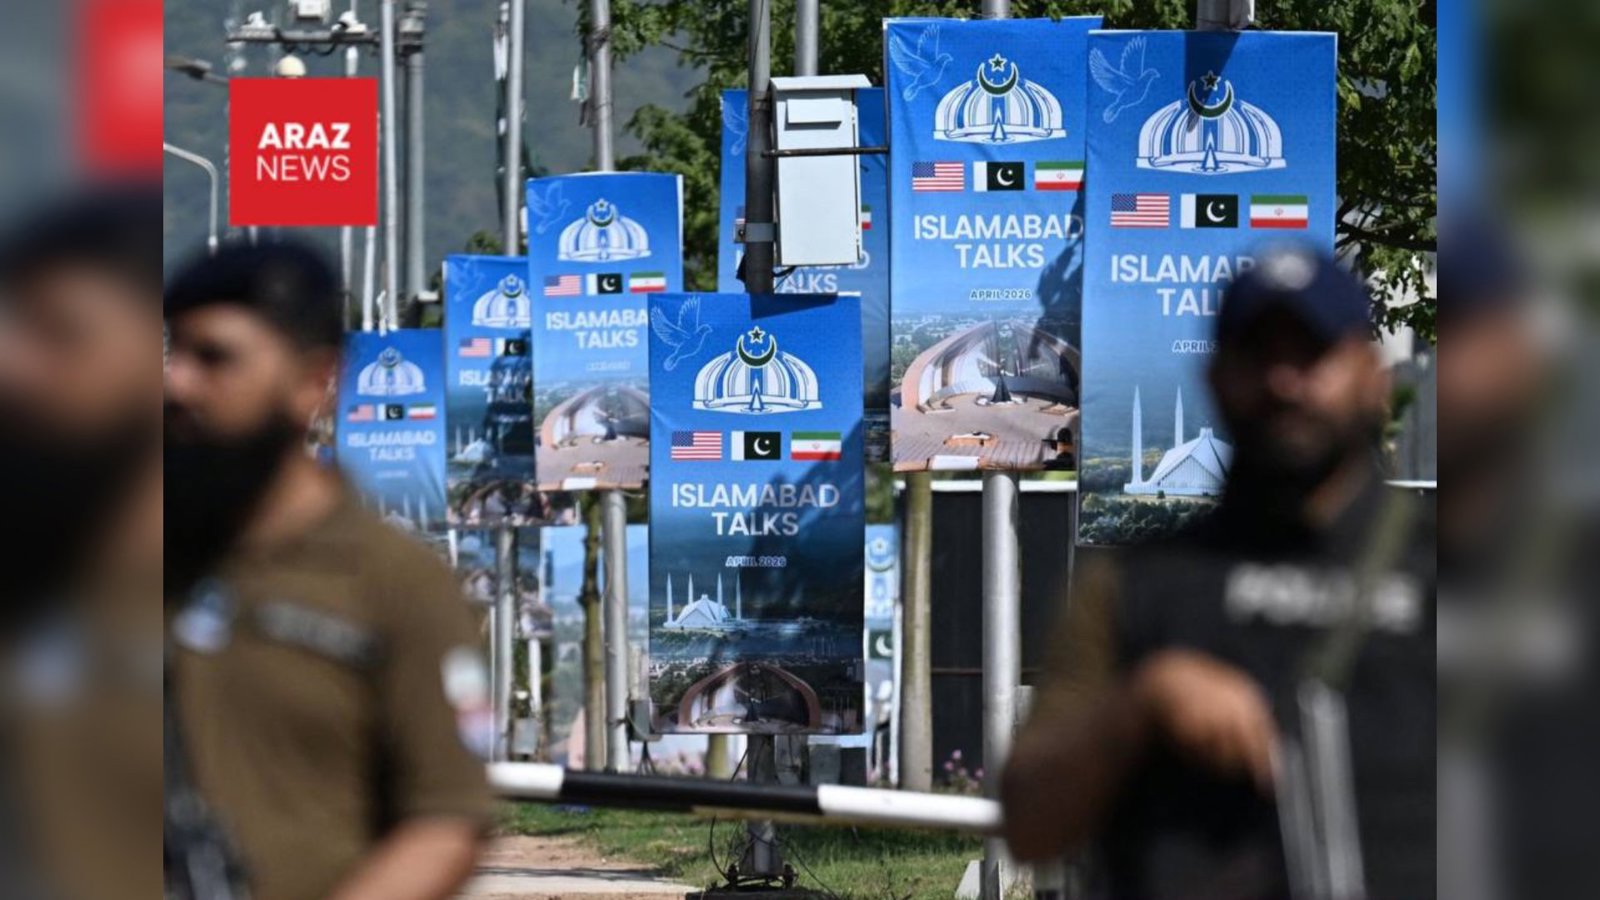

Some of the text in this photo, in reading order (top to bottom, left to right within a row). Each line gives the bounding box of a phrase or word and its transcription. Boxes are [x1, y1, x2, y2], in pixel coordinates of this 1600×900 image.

[914, 215, 1084, 240] ISLAMABAD
[954, 243, 1045, 268] TALKS
[969, 288, 1032, 300] APRIL 2026
[1156, 288, 1223, 317] TAL
[546, 309, 649, 330] ISLAMABA
[575, 329, 639, 349] TALKS
[1172, 339, 1209, 353] APRIL
[347, 430, 436, 447] ISLAMABAD
[369, 446, 415, 462] TALKS
[672, 483, 840, 508] ISLAMABAD
[711, 511, 799, 536] TALKS
[725, 555, 757, 567] APRIL
